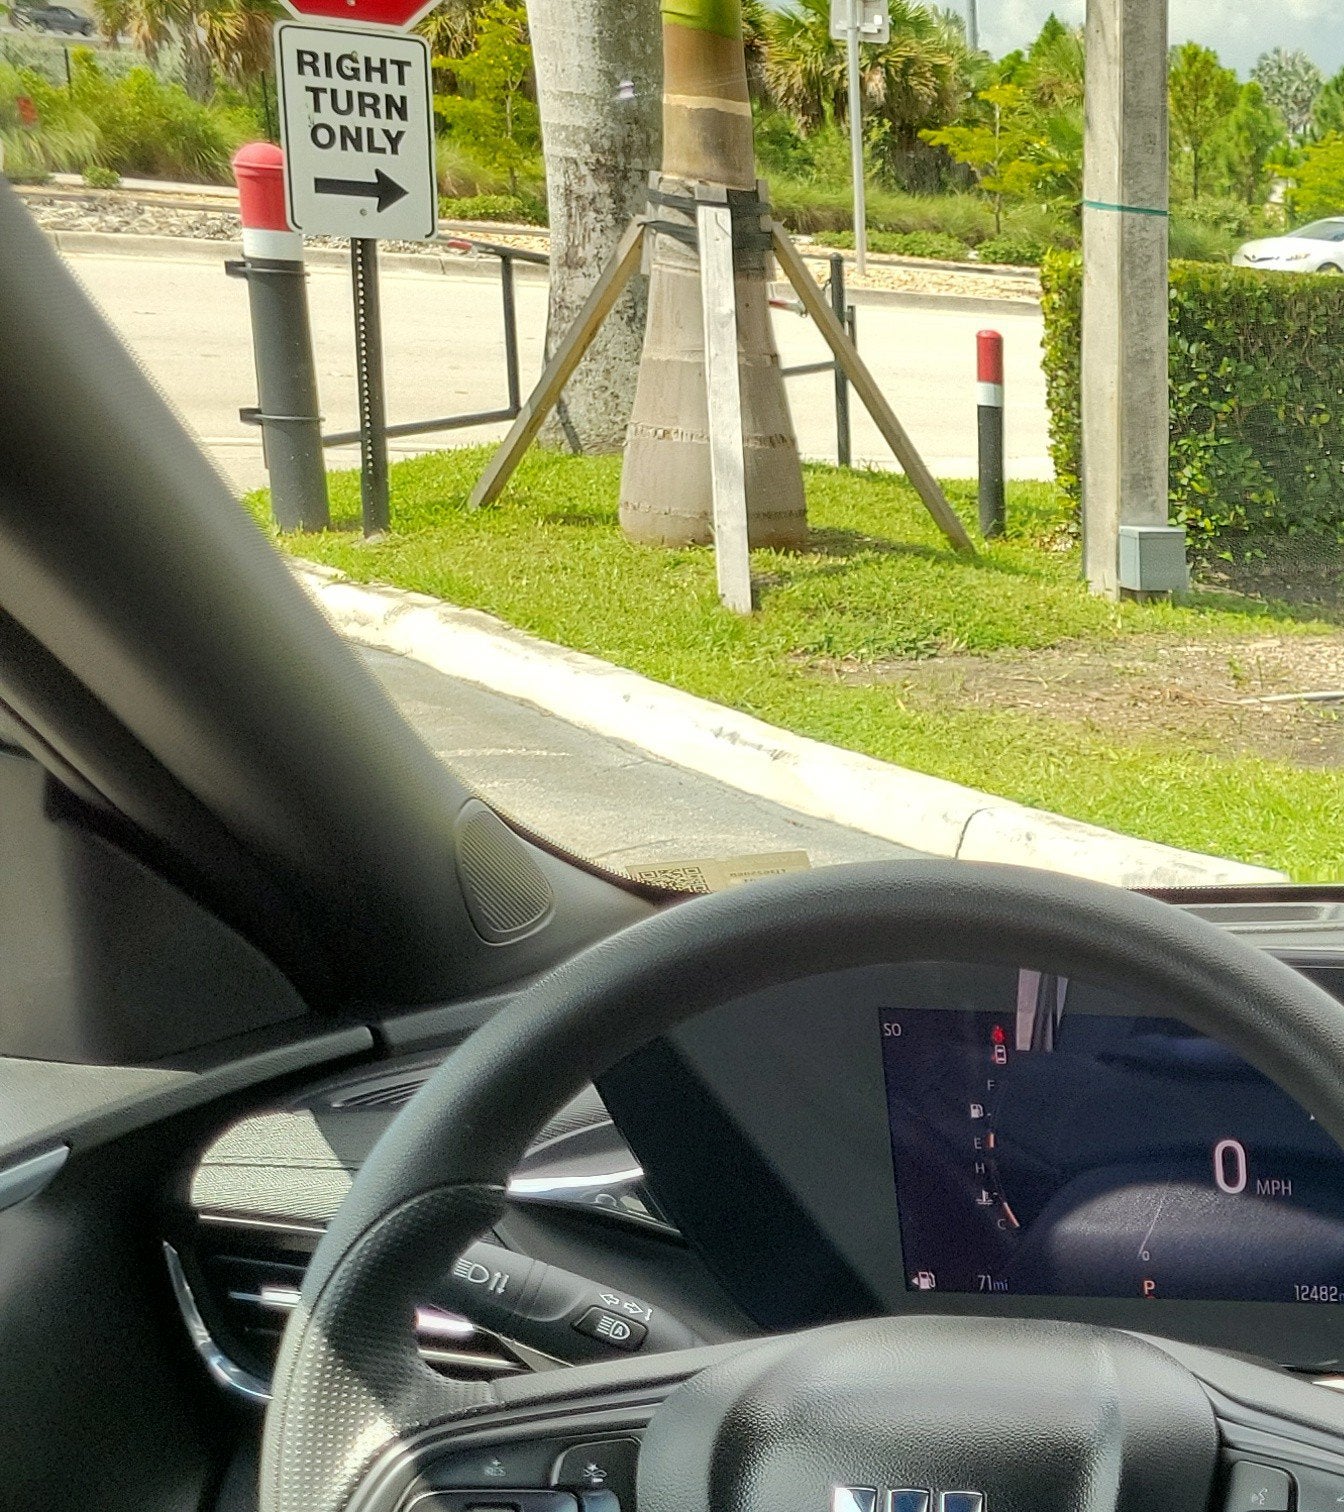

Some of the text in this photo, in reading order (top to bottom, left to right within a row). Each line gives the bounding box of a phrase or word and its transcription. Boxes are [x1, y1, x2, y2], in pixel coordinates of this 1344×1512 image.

[296, 48, 412, 87] RIGHT
[305, 85, 409, 122] TURN
[310, 122, 406, 155] ONLY
[883, 1022, 902, 1037] SO
[987, 1079, 995, 1091] F
[973, 1137, 983, 1150] E
[975, 1162, 986, 1174] H
[1214, 1139, 1292, 1196] 0 MPH
[1143, 1280, 1155, 1295] P
